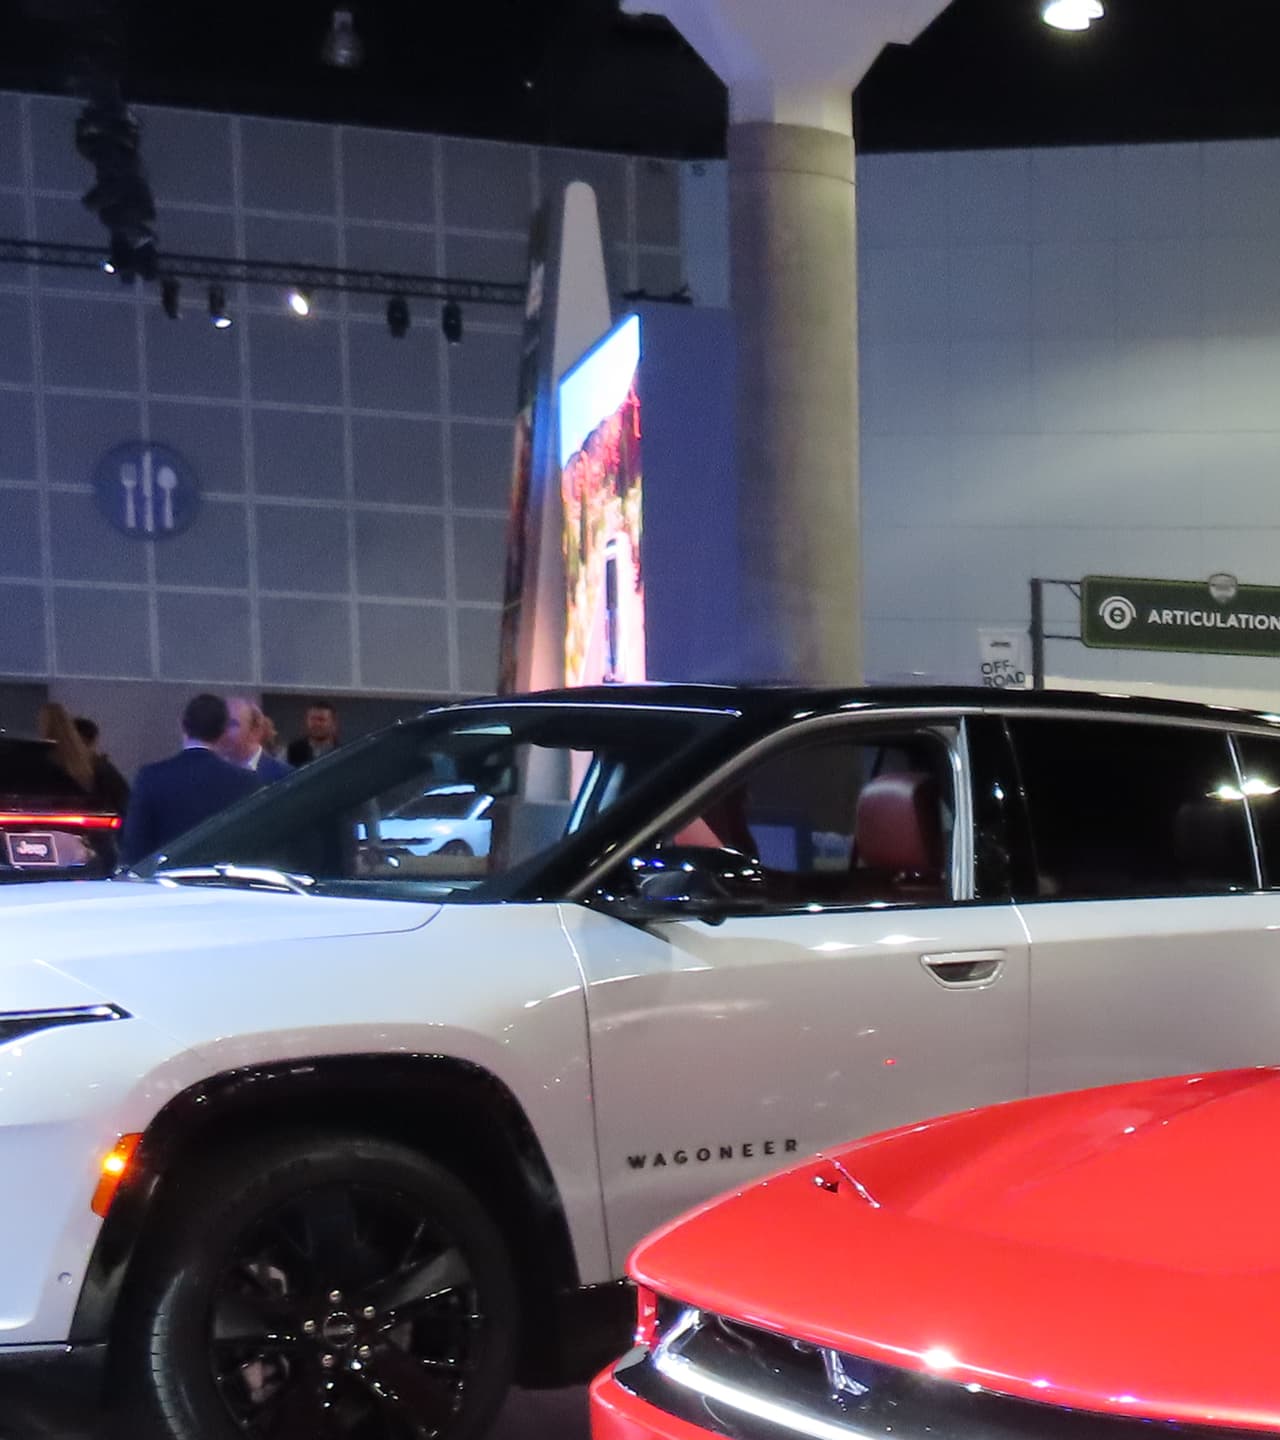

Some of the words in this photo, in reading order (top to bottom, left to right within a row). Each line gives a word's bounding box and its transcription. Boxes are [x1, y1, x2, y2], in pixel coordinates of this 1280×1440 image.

[982, 671, 1026, 688] ROAD
[16, 840, 48, 857] Jeep
[627, 1139, 797, 1169] WAGONEER
